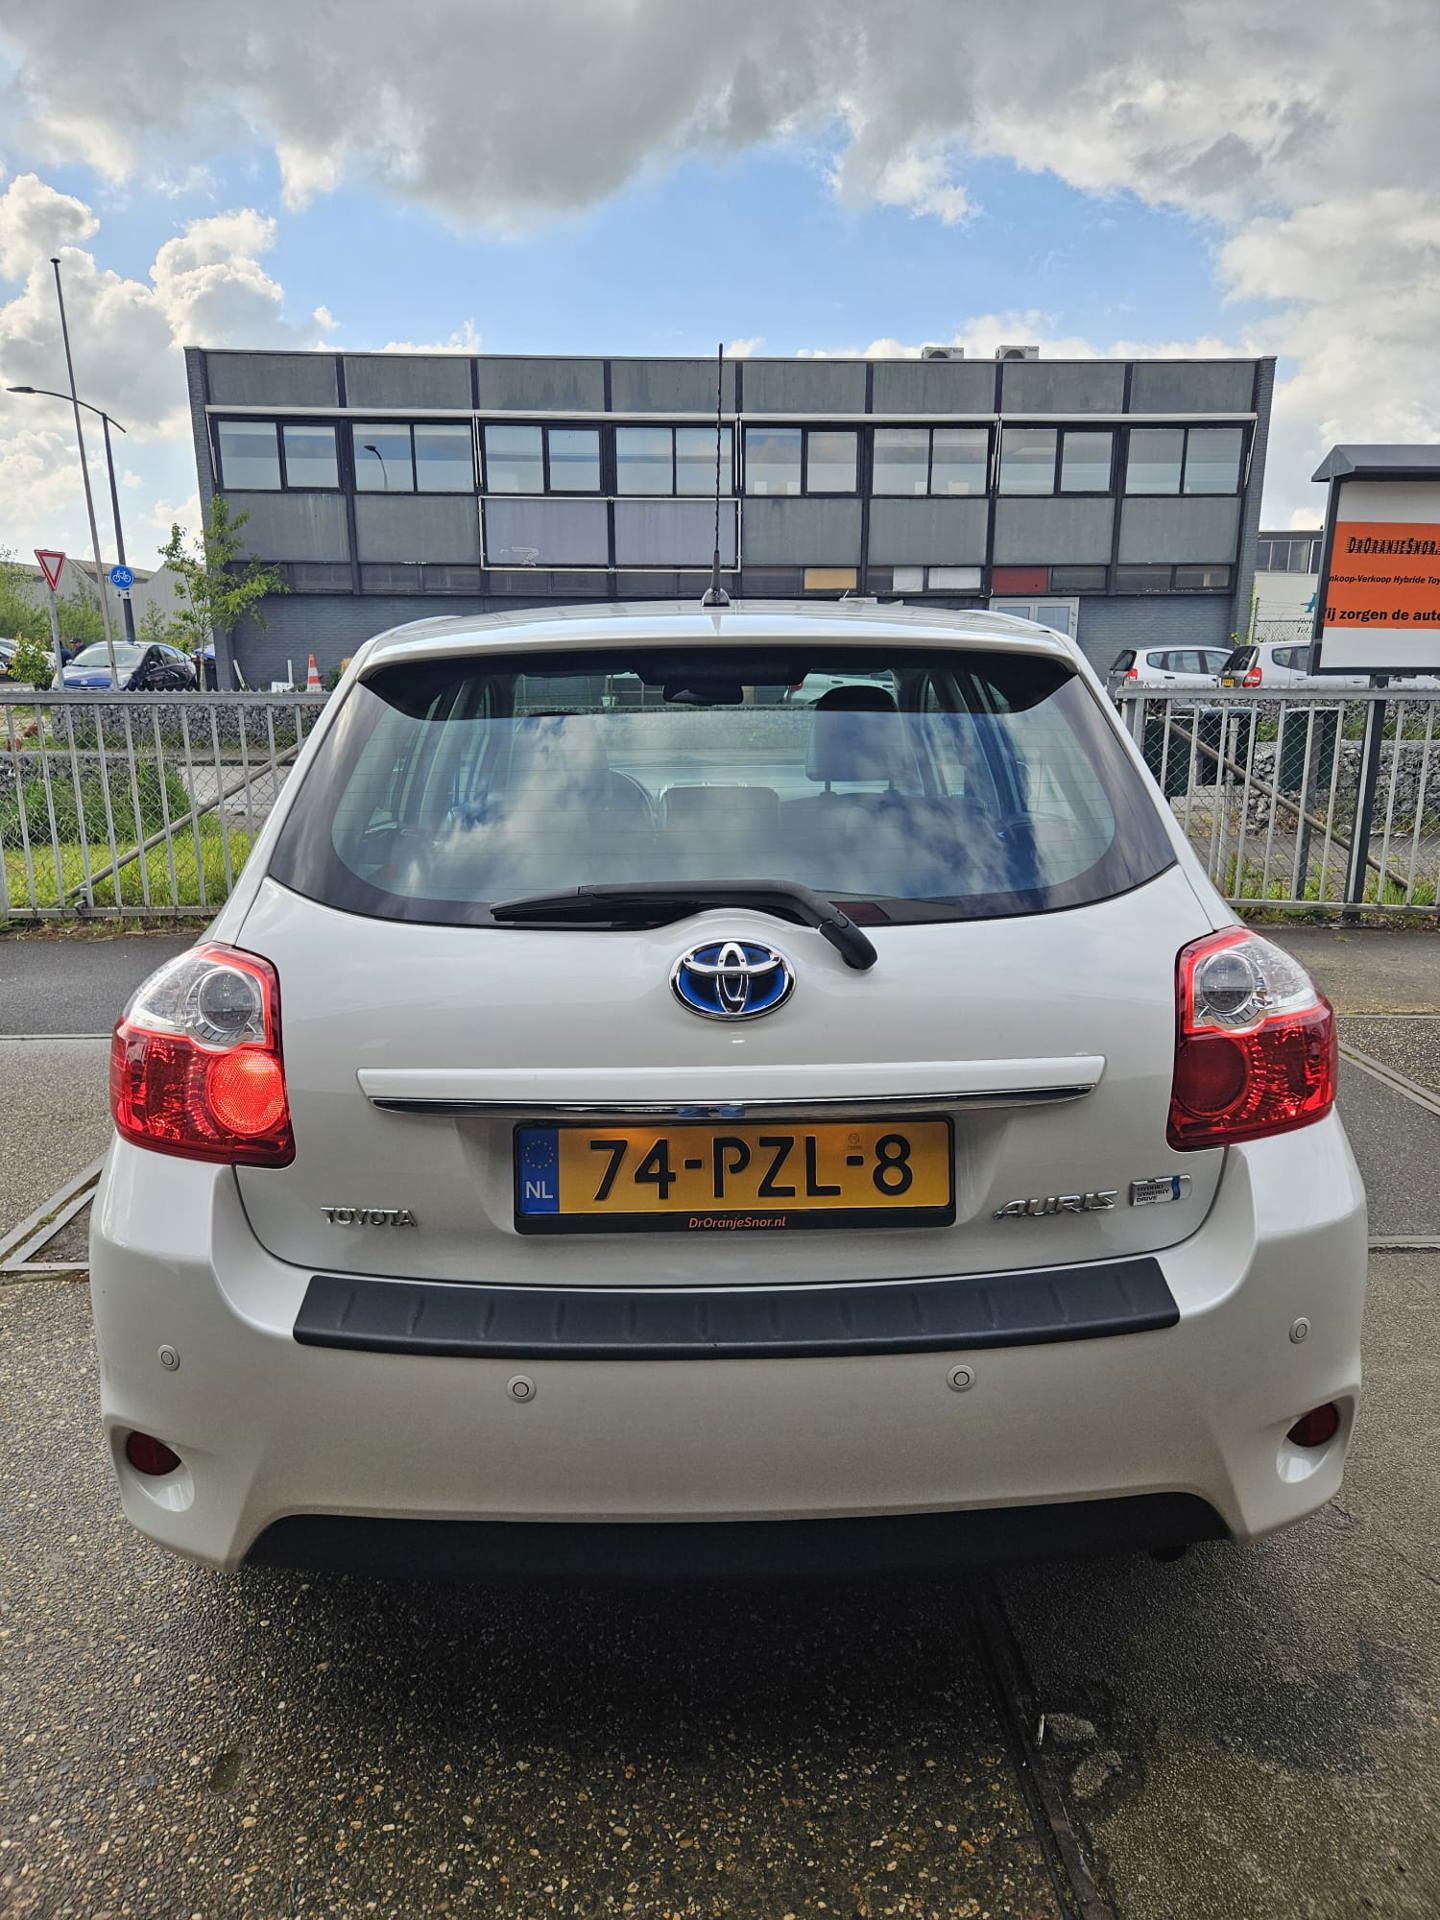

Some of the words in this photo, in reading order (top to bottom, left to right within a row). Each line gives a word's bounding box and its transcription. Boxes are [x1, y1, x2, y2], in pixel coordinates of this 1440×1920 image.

[1329, 575, 1391, 584] nkoop-Verkoop
[1393, 575, 1426, 585] Hybride
[1339, 610, 1388, 622] zorgen
[1391, 609, 1409, 621] de
[589, 1134, 913, 1201] 74-PZL-8
[526, 1181, 554, 1199] NL
[993, 1190, 1118, 1219] AURIS
[320, 1207, 418, 1227] TOYOTA
[688, 1216, 786, 1230] DrOranjeSnor.nl
